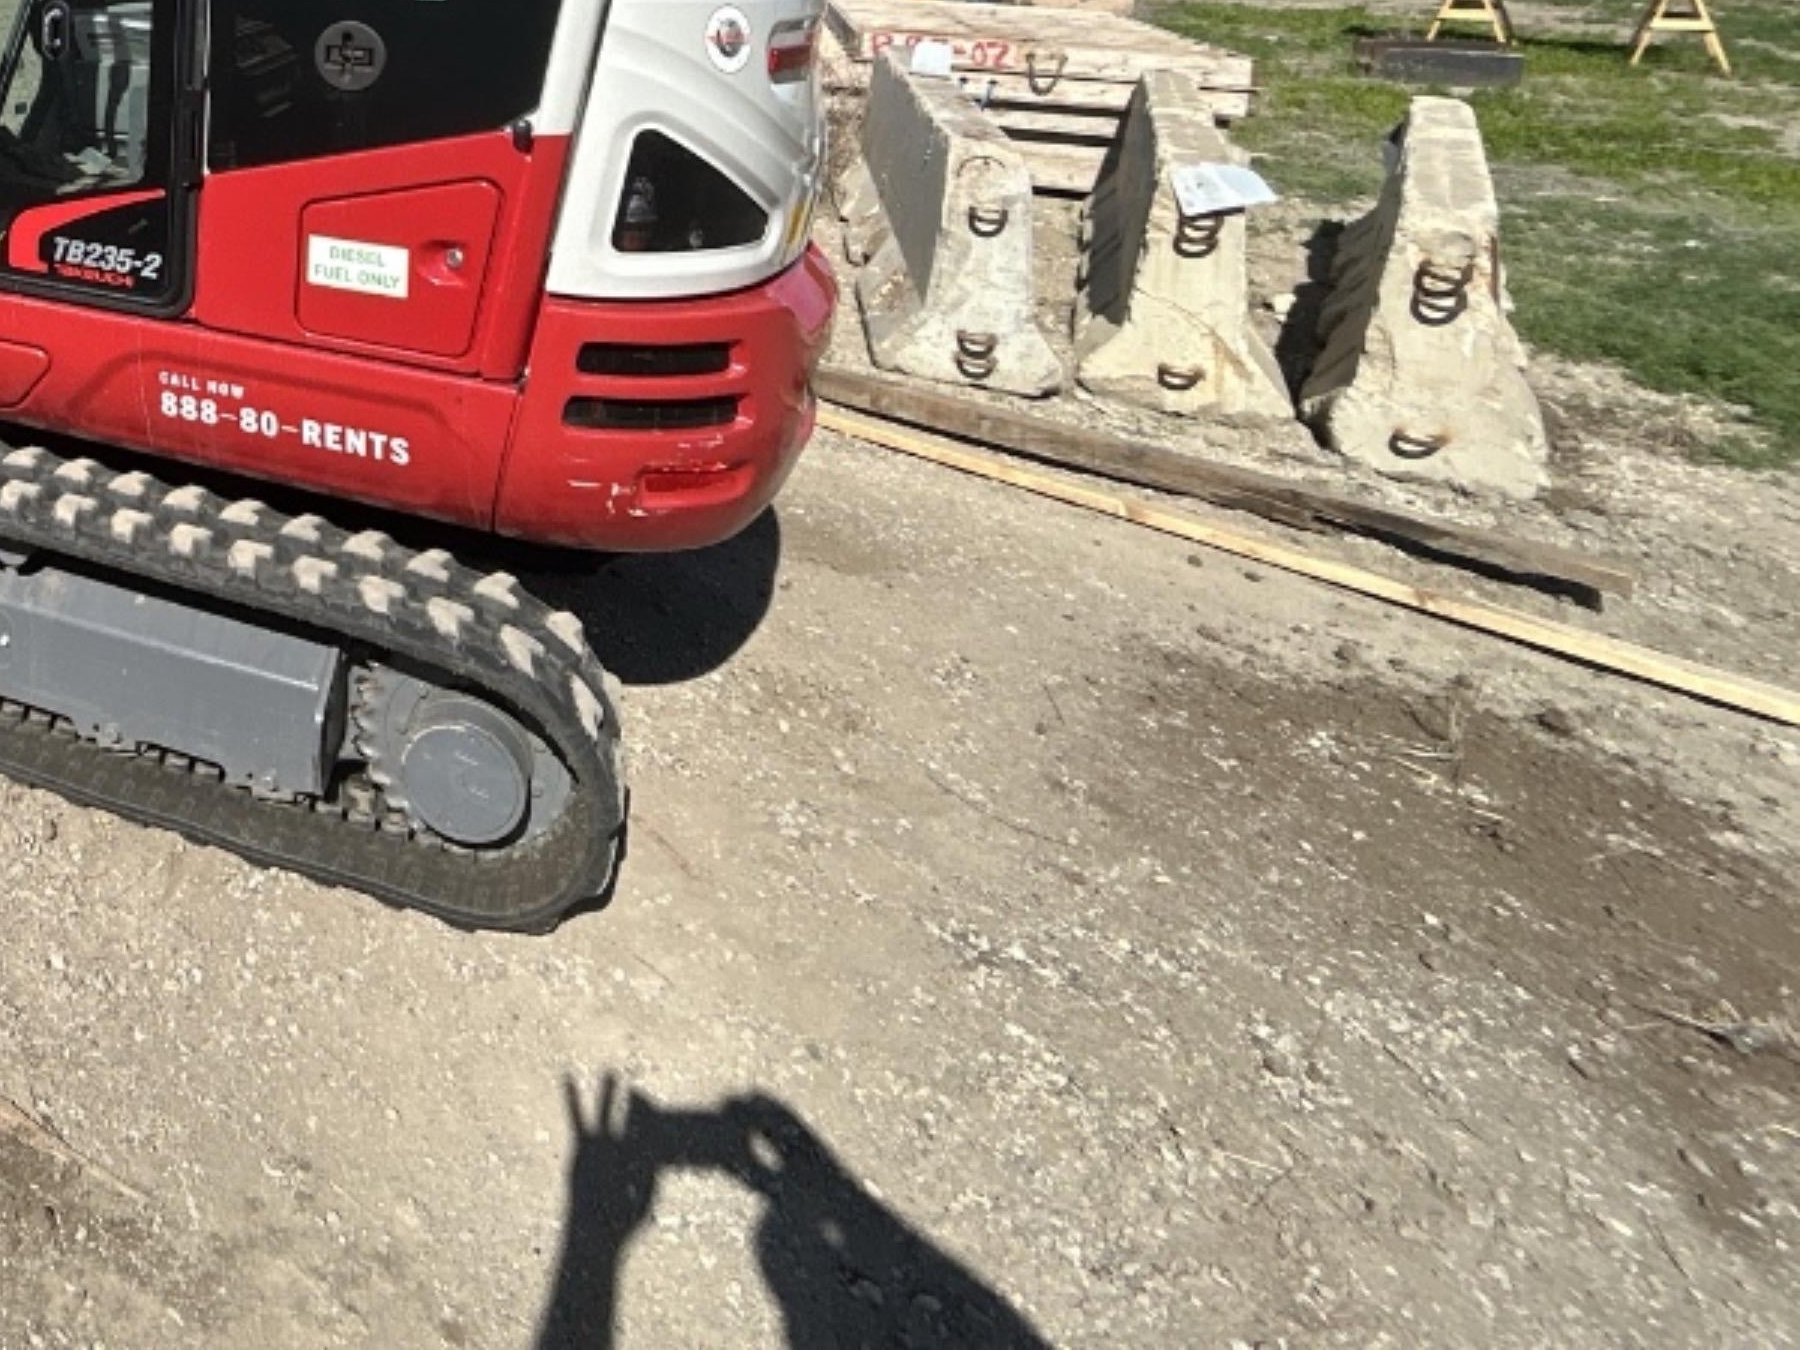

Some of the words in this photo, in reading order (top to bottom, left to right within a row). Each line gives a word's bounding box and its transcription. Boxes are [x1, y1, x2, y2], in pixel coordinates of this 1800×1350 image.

[53, 236, 164, 280] TB235-2
[329, 245, 386, 268] DIESEL
[314, 263, 353, 283] FUEL
[356, 269, 401, 290] ONLY
[158, 370, 201, 392] CALL
[206, 379, 245, 400] NOW
[160, 390, 410, 466] 888-80-RENTS
